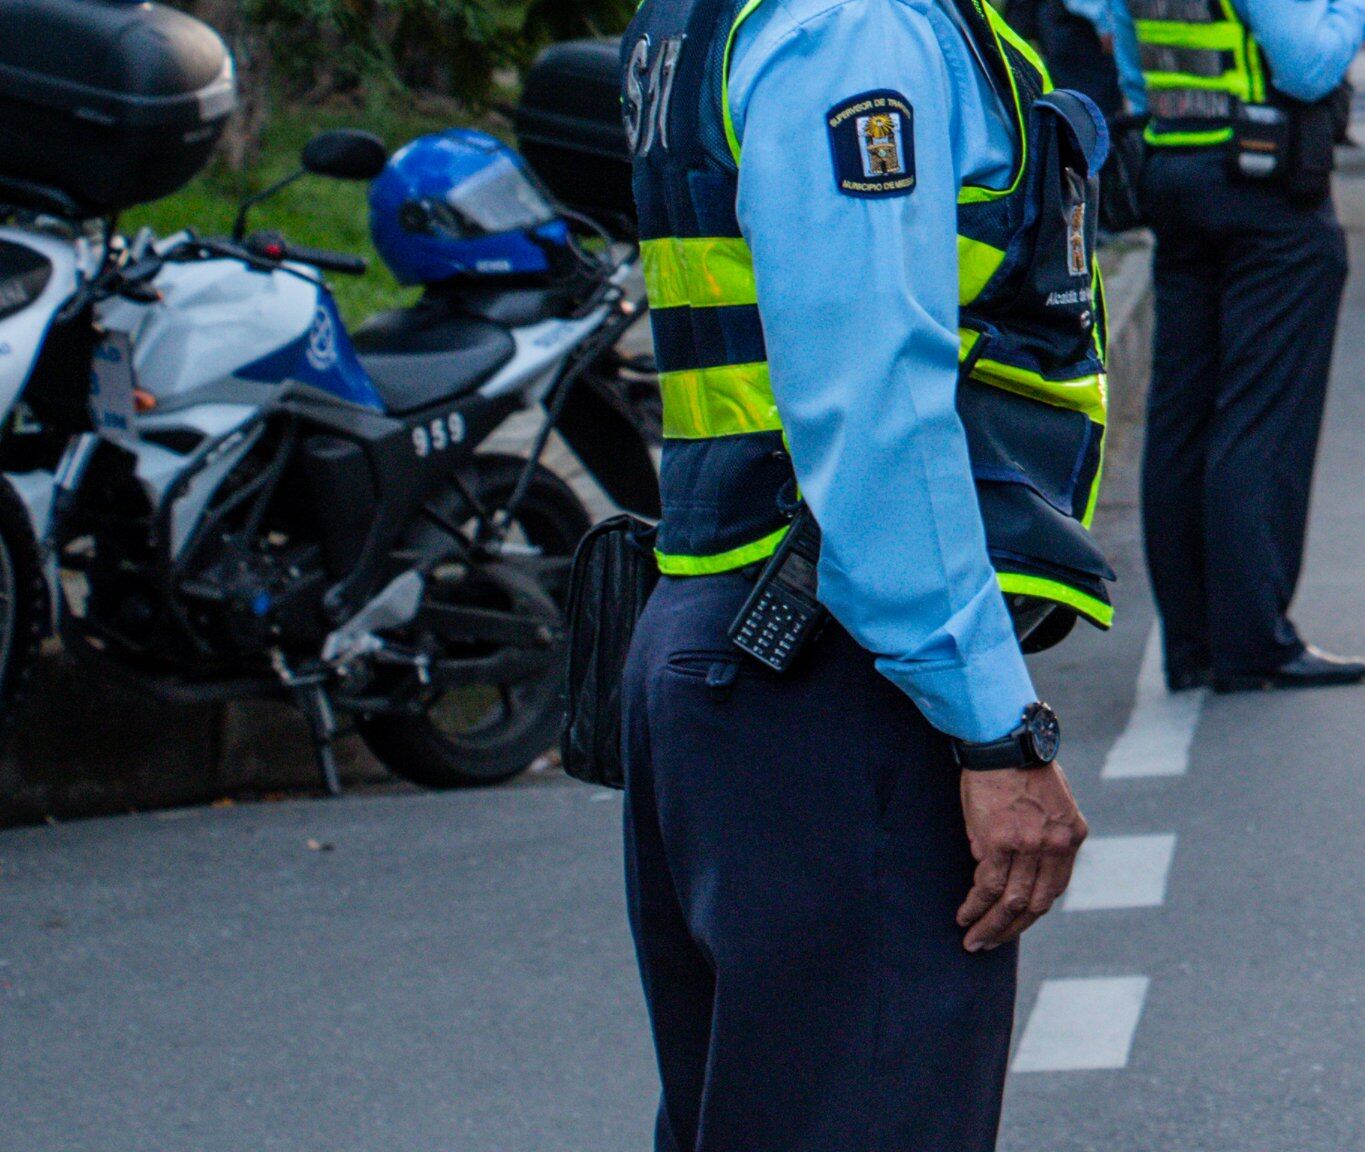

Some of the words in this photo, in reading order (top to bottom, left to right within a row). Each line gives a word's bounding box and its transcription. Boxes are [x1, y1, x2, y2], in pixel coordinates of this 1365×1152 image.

[830, 101, 872, 127] SUPERVISOR
[873, 98, 886, 107] DE
[842, 180, 882, 190] MUNICIPIO
[883, 181, 895, 189] DE
[412, 411, 465, 458] 959
